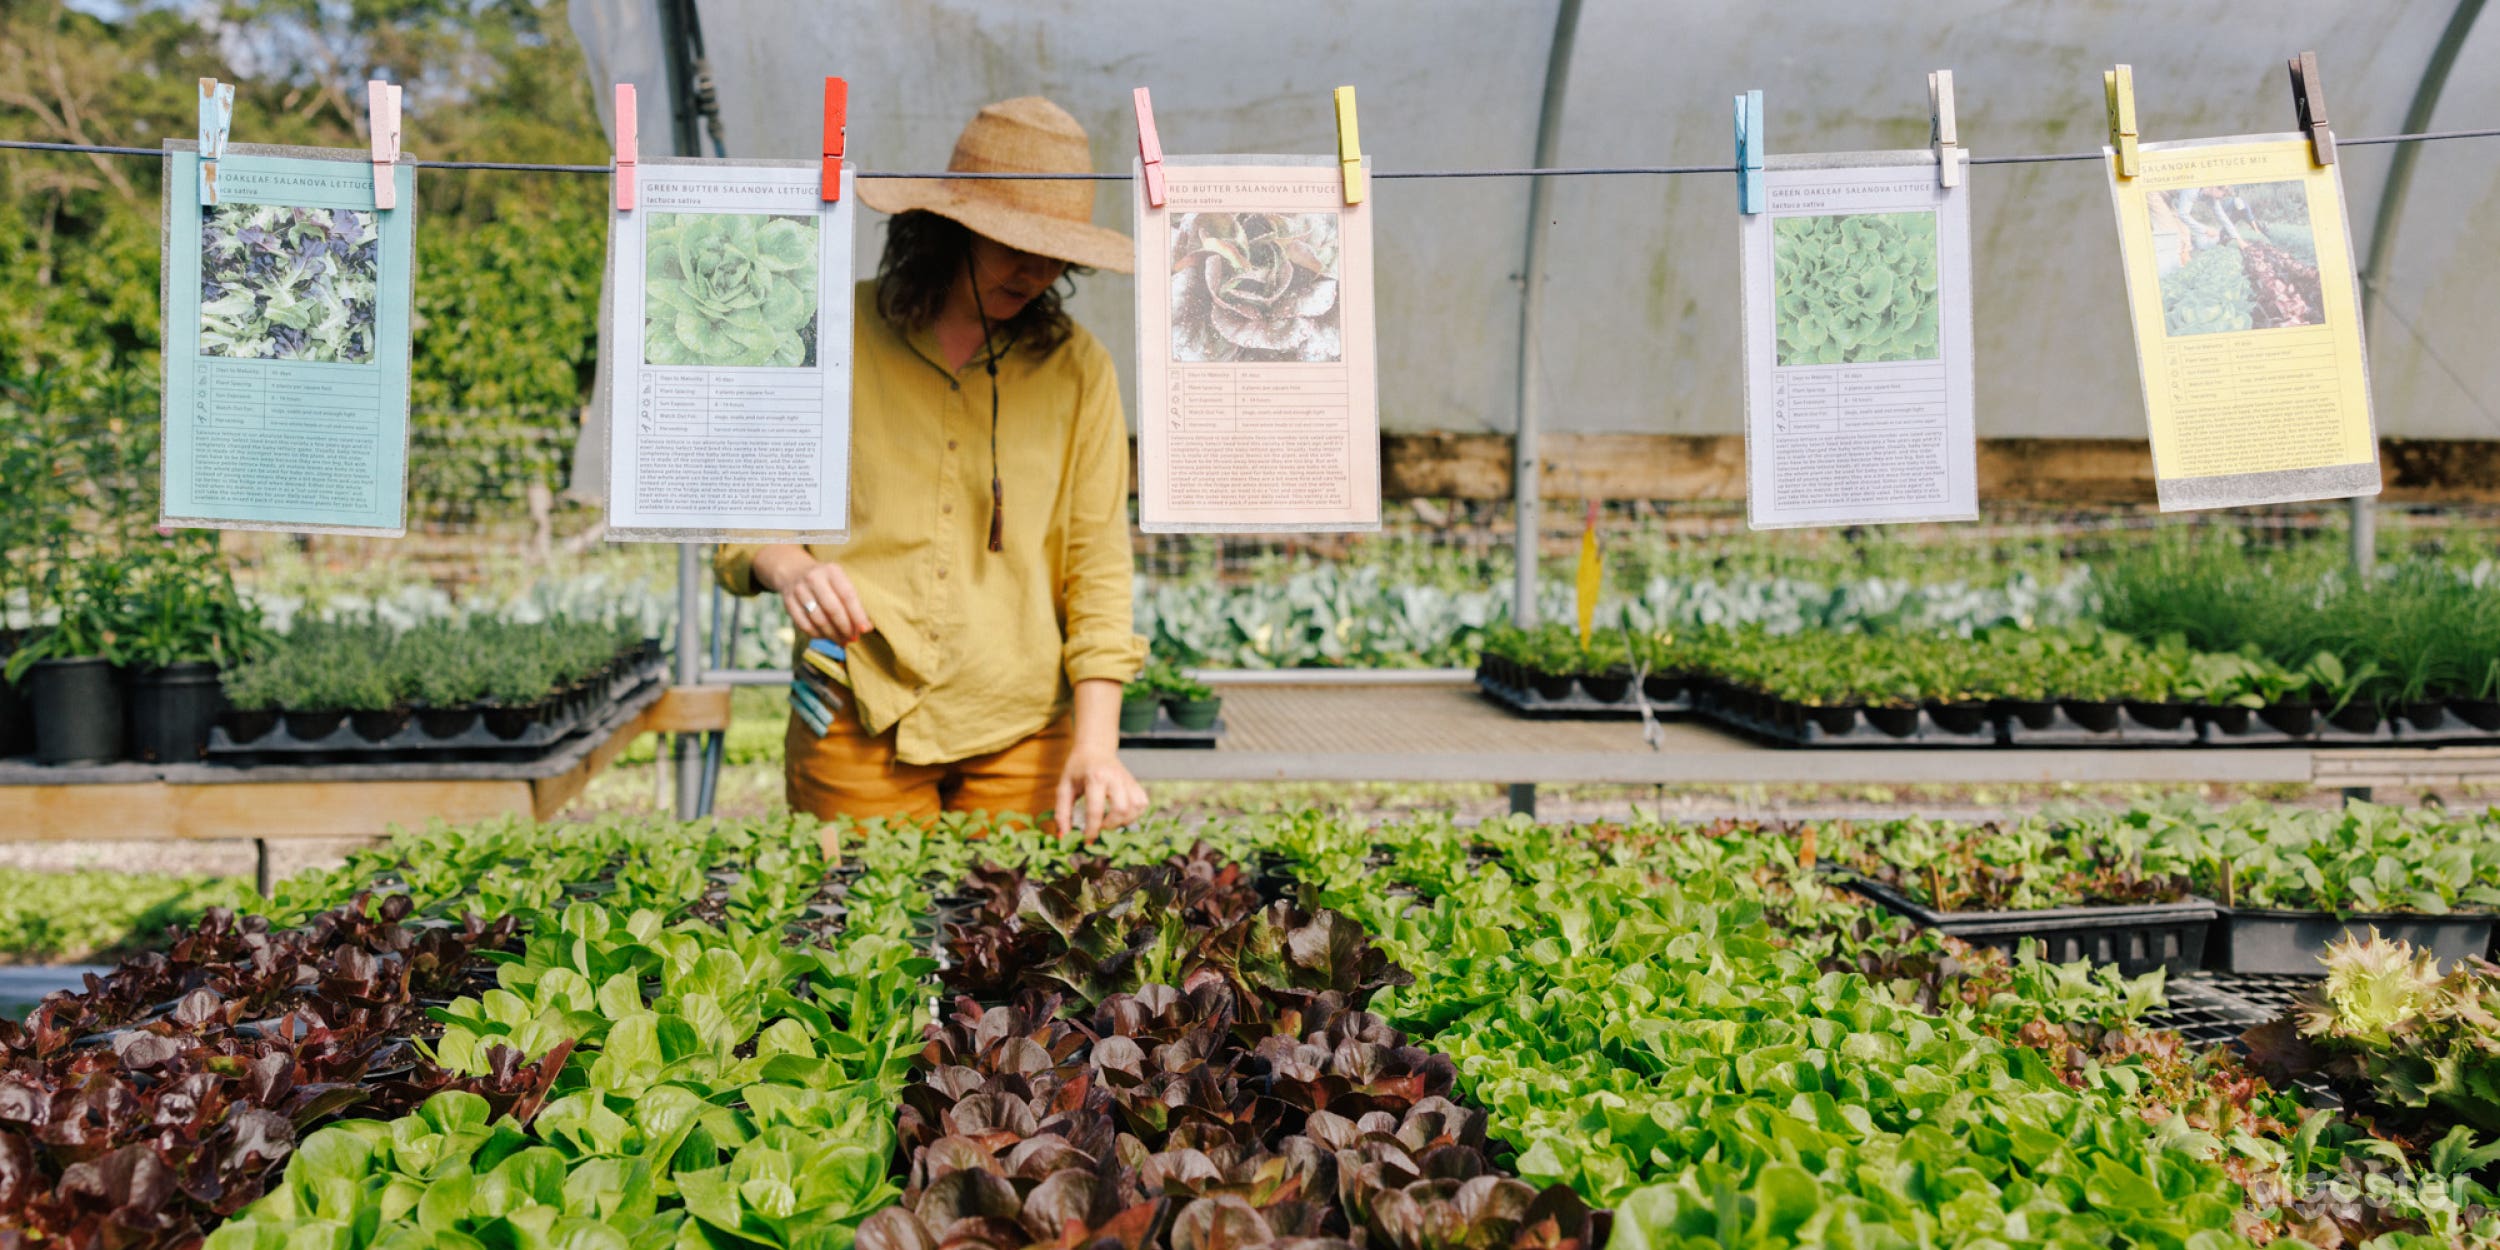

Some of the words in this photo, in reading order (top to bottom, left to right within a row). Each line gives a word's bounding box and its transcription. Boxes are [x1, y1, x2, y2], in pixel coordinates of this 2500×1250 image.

[2141, 162, 2197, 173] SALANOVA
[2200, 158, 2245, 168] LETTUCE
[2250, 156, 2268, 164] MIX
[226, 175, 270, 184] OAKLEAF
[274, 177, 326, 187] SALANOVA
[331, 180, 374, 189] LETTUCE
[647, 184, 678, 192] GREEN
[723, 186, 773, 194] SALANOVA
[1772, 189, 1800, 197] GREEN
[1804, 188, 1841, 196] OAKLEAF
[1845, 186, 1890, 194] SALANOVA
[1894, 184, 1930, 192] LETTUCE
